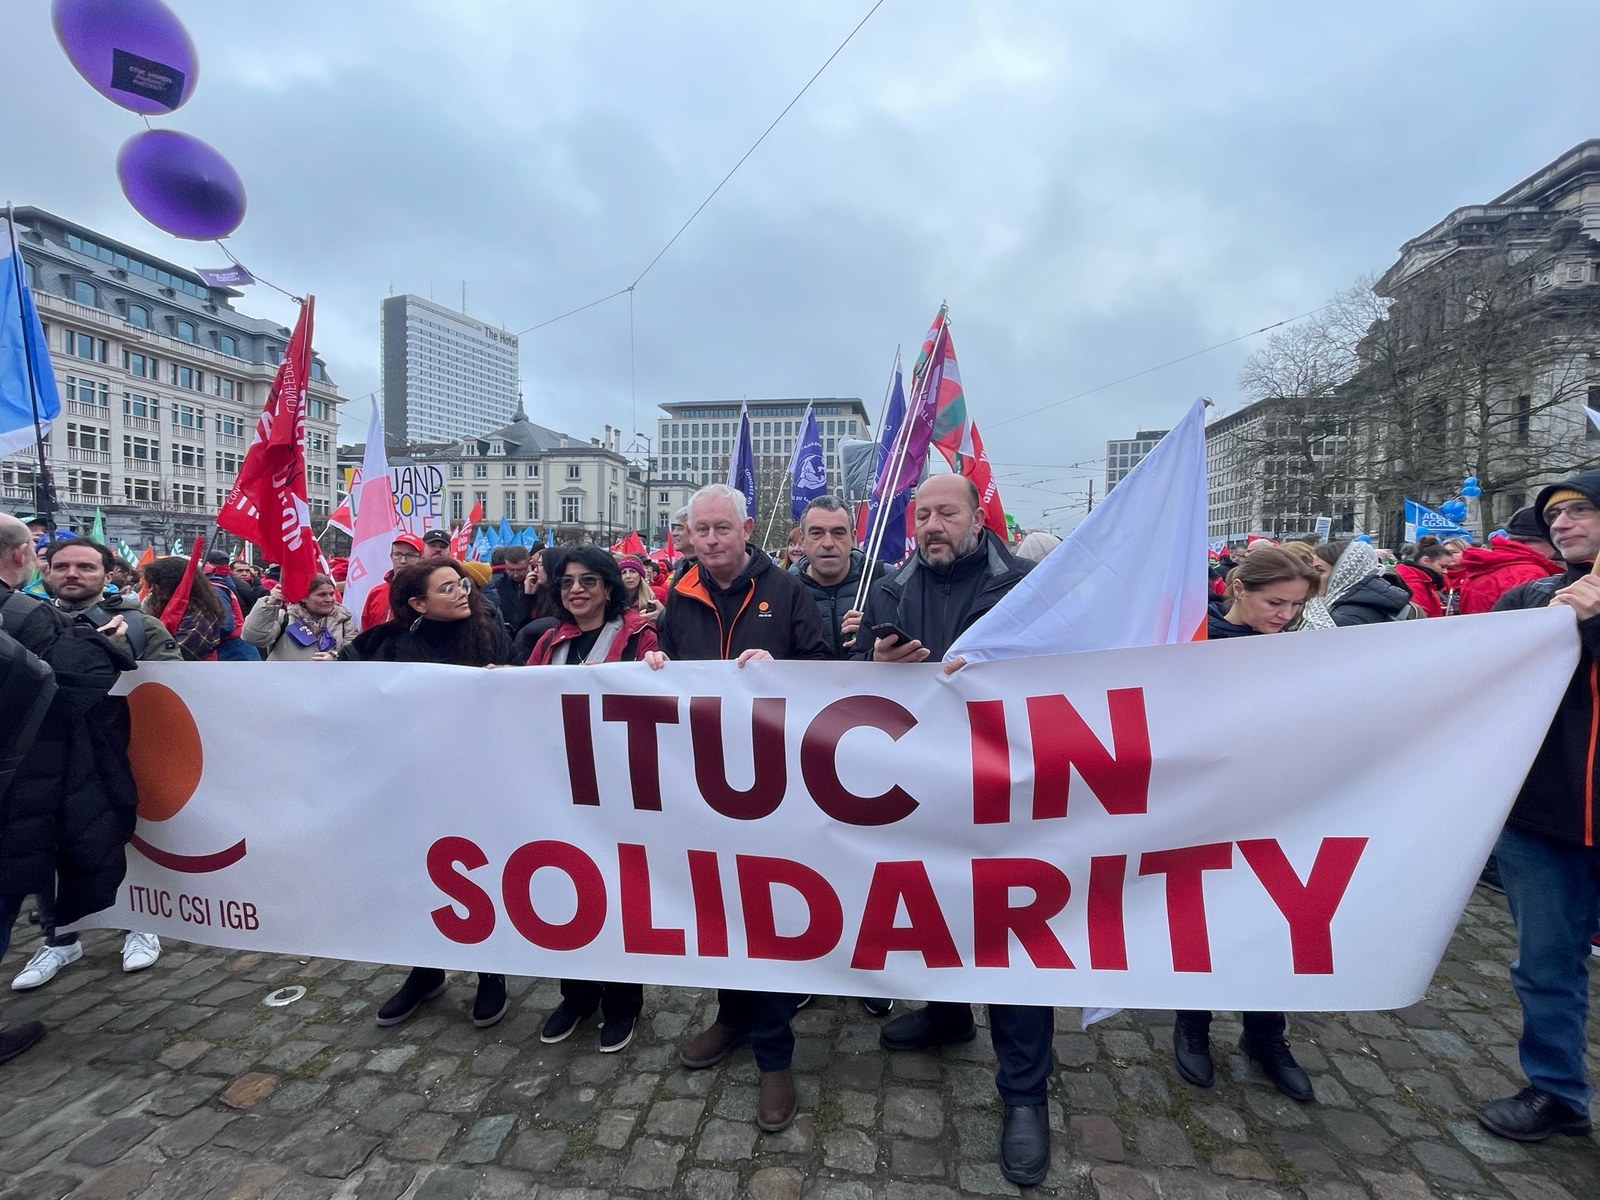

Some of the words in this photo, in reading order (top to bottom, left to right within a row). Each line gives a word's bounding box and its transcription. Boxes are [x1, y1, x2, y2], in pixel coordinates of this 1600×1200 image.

[484, 326, 498, 341] The
[500, 332, 518, 348] Hotel
[561, 693, 920, 826] ITUC
[966, 686, 1152, 825] IN
[129, 885, 172, 918] ITUC
[178, 894, 211, 926] CSI
[219, 900, 260, 931] IGB
[426, 835, 1369, 975] SOLIDARITY
